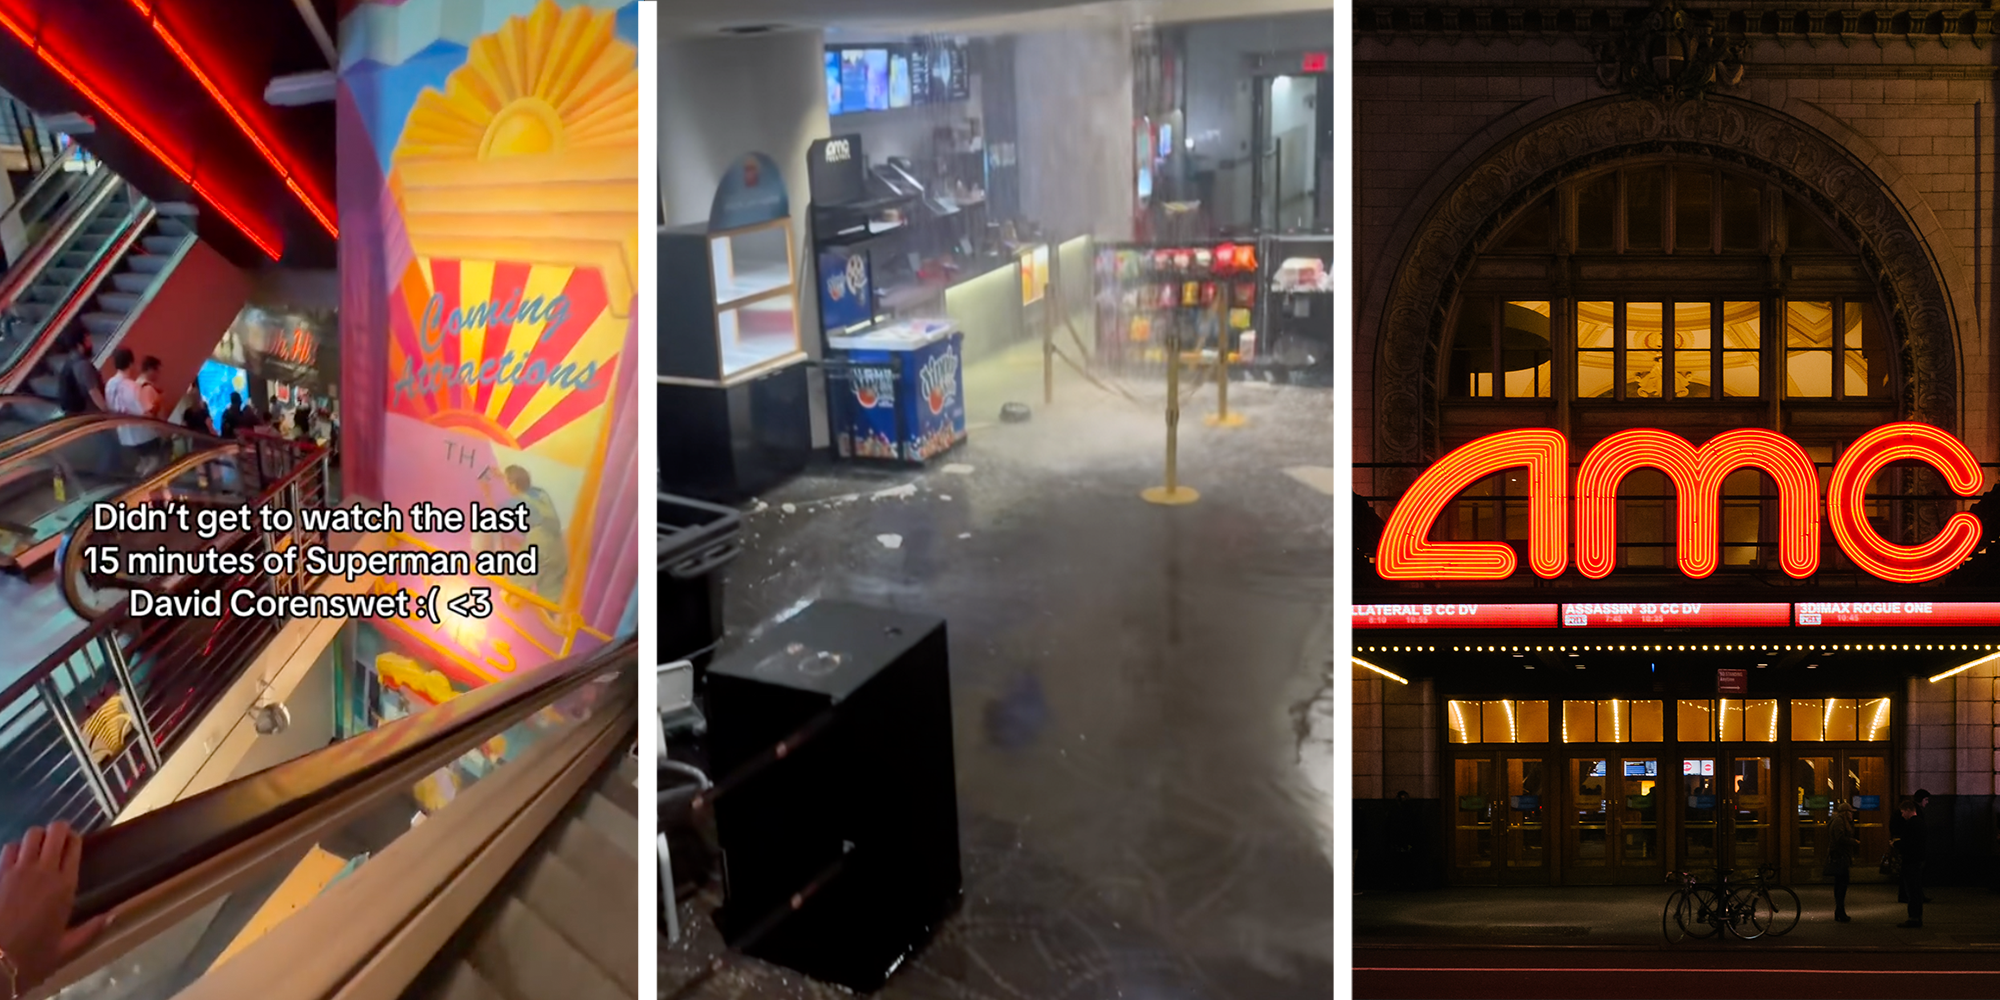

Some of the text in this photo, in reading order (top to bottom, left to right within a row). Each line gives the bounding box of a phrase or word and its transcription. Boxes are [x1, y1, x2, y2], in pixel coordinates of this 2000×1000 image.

[420, 288, 572, 353] Coming
[393, 350, 601, 407] Attractions
[1376, 421, 1985, 583] amc
[1423, 604, 1433, 616] B
[1436, 604, 1455, 616] CC
[1459, 604, 1478, 616] DV
[1565, 603, 1701, 615] ASSASSIN' 3D CC DV
[1800, 602, 1933, 614] 3DIMAX ROGUE ONE
[1406, 616, 1428, 624] 10:55
[1605, 615, 1664, 623] 7:45 10:35
[1837, 614, 1859, 622] 10:45
